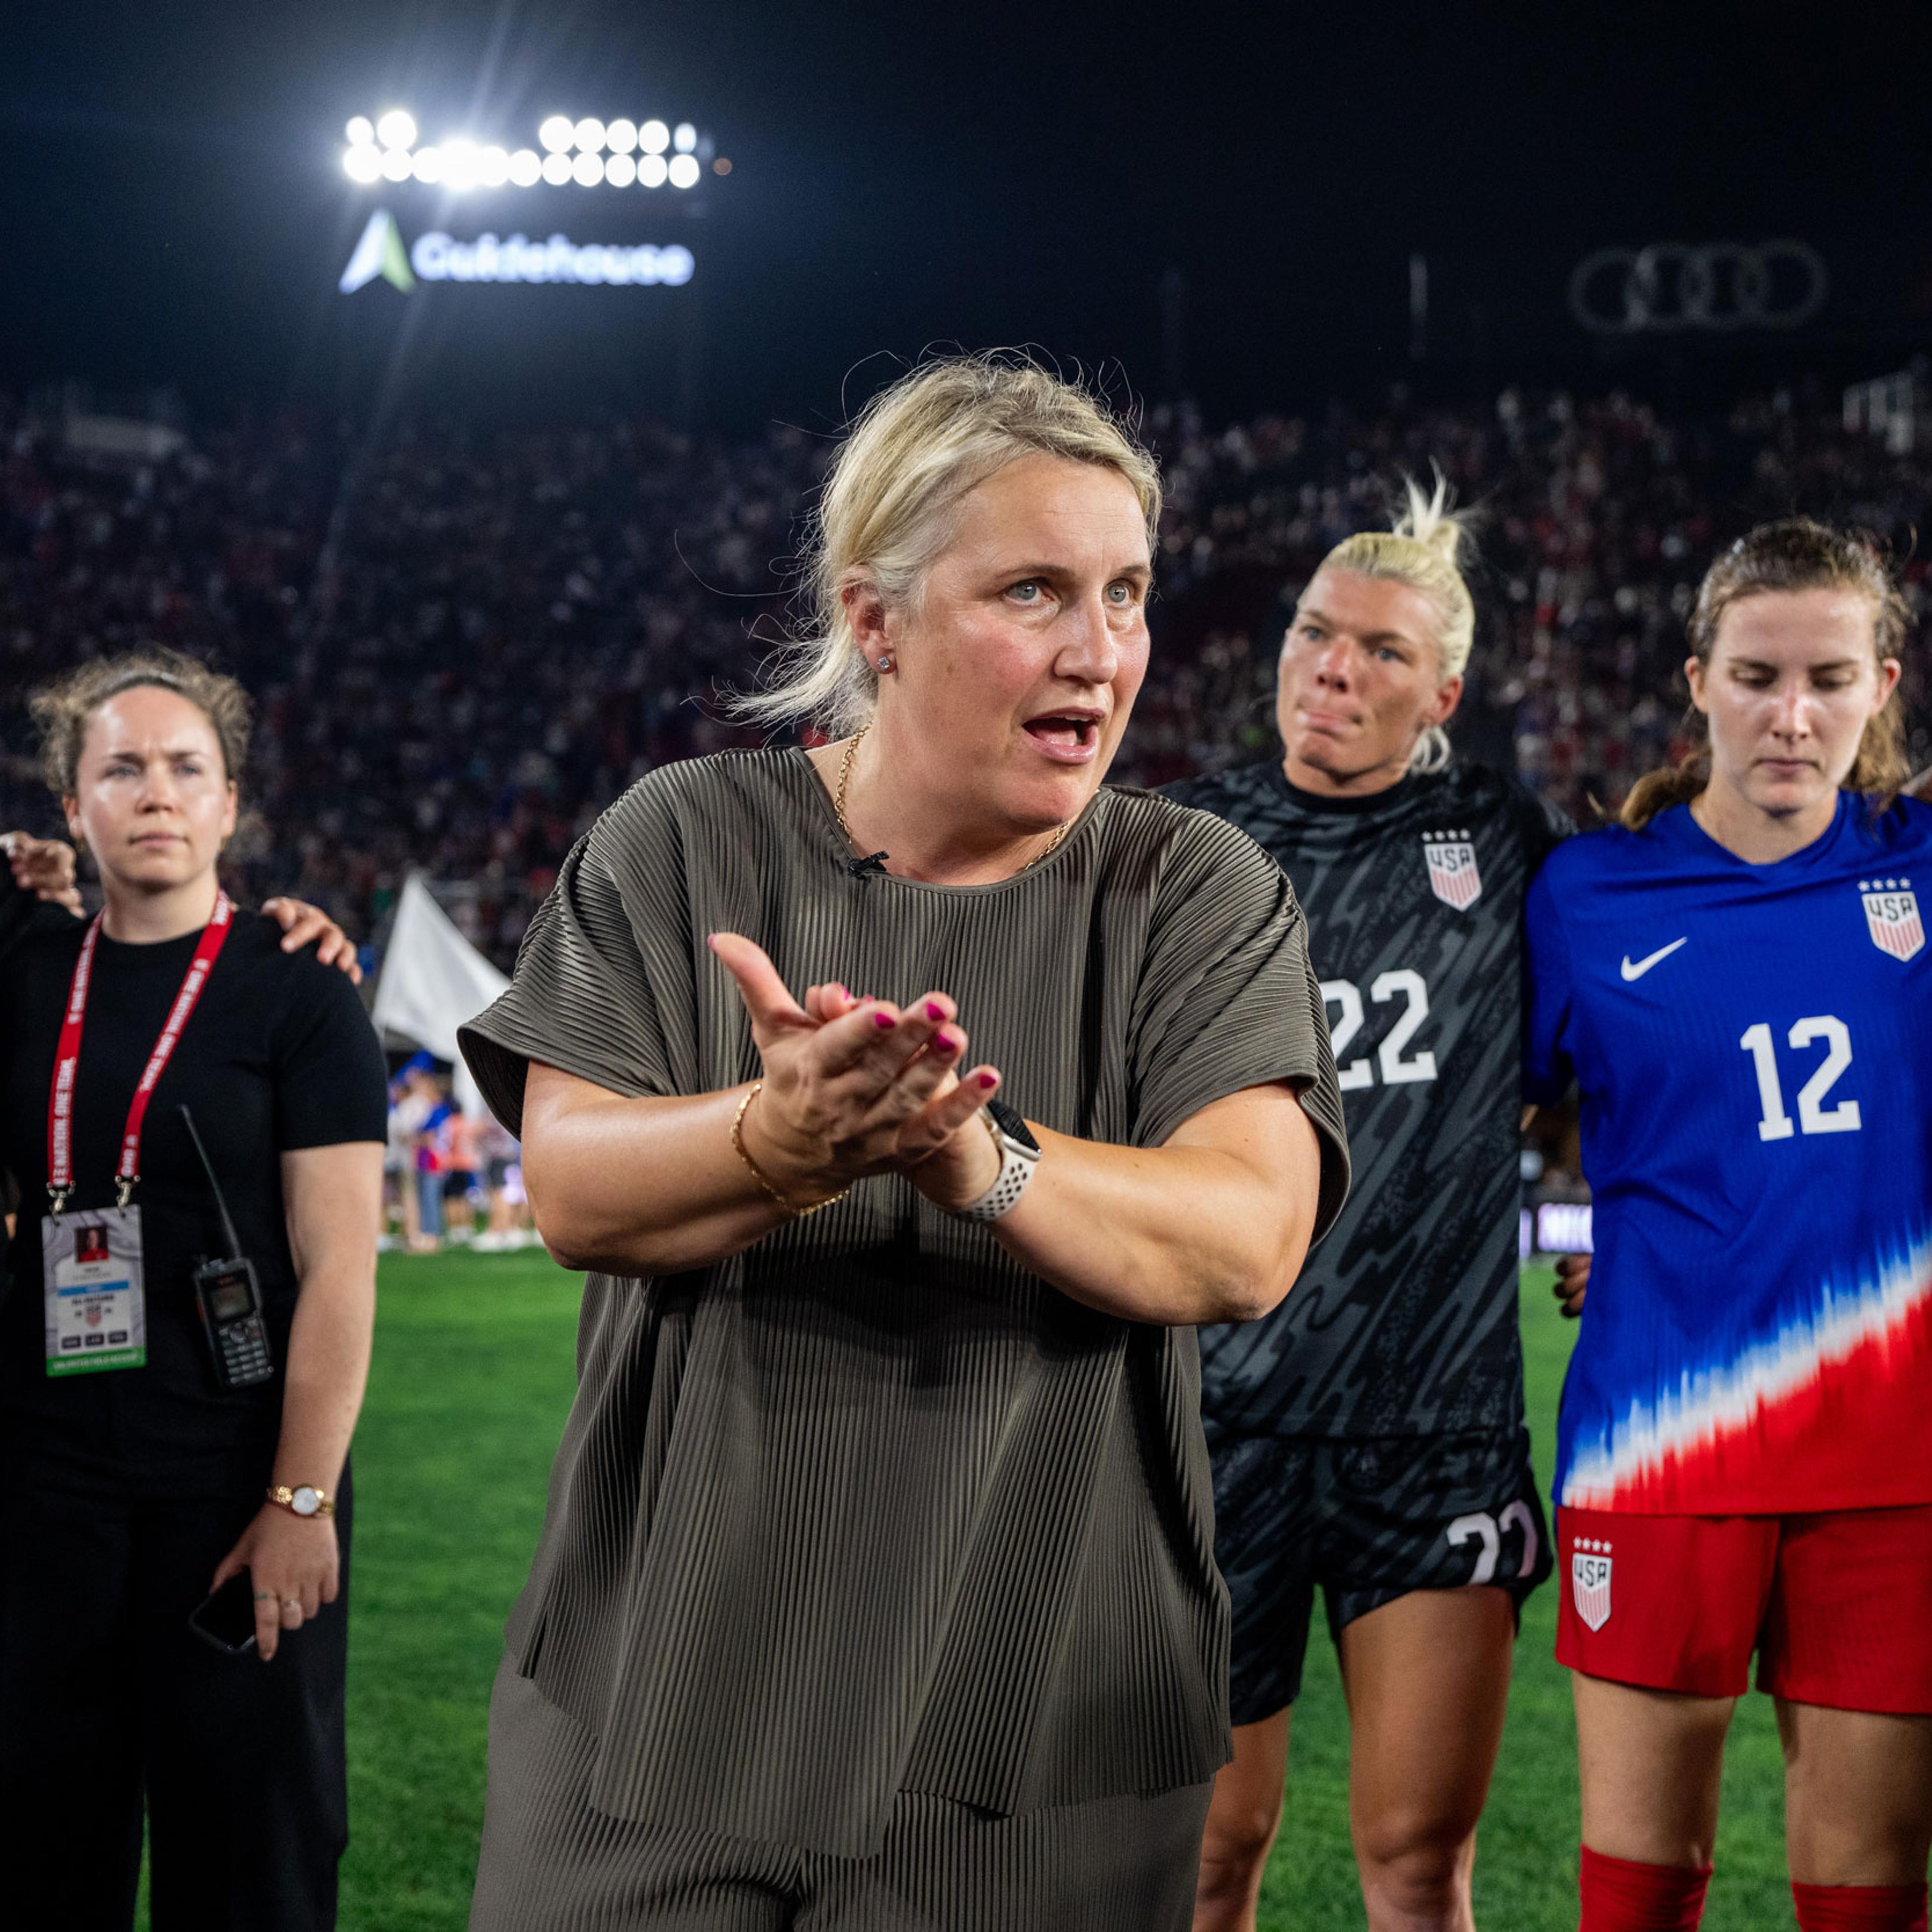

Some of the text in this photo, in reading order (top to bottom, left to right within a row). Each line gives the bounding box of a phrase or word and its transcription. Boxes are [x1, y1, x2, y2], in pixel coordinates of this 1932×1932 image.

[412, 232, 695, 286] Guidehouse
[1430, 848, 1470, 871] USA
[1868, 897, 1913, 922] USA
[1319, 969, 1438, 1091] 22
[1739, 1014, 1862, 1142] 12
[1574, 1557, 1607, 1587] USA
